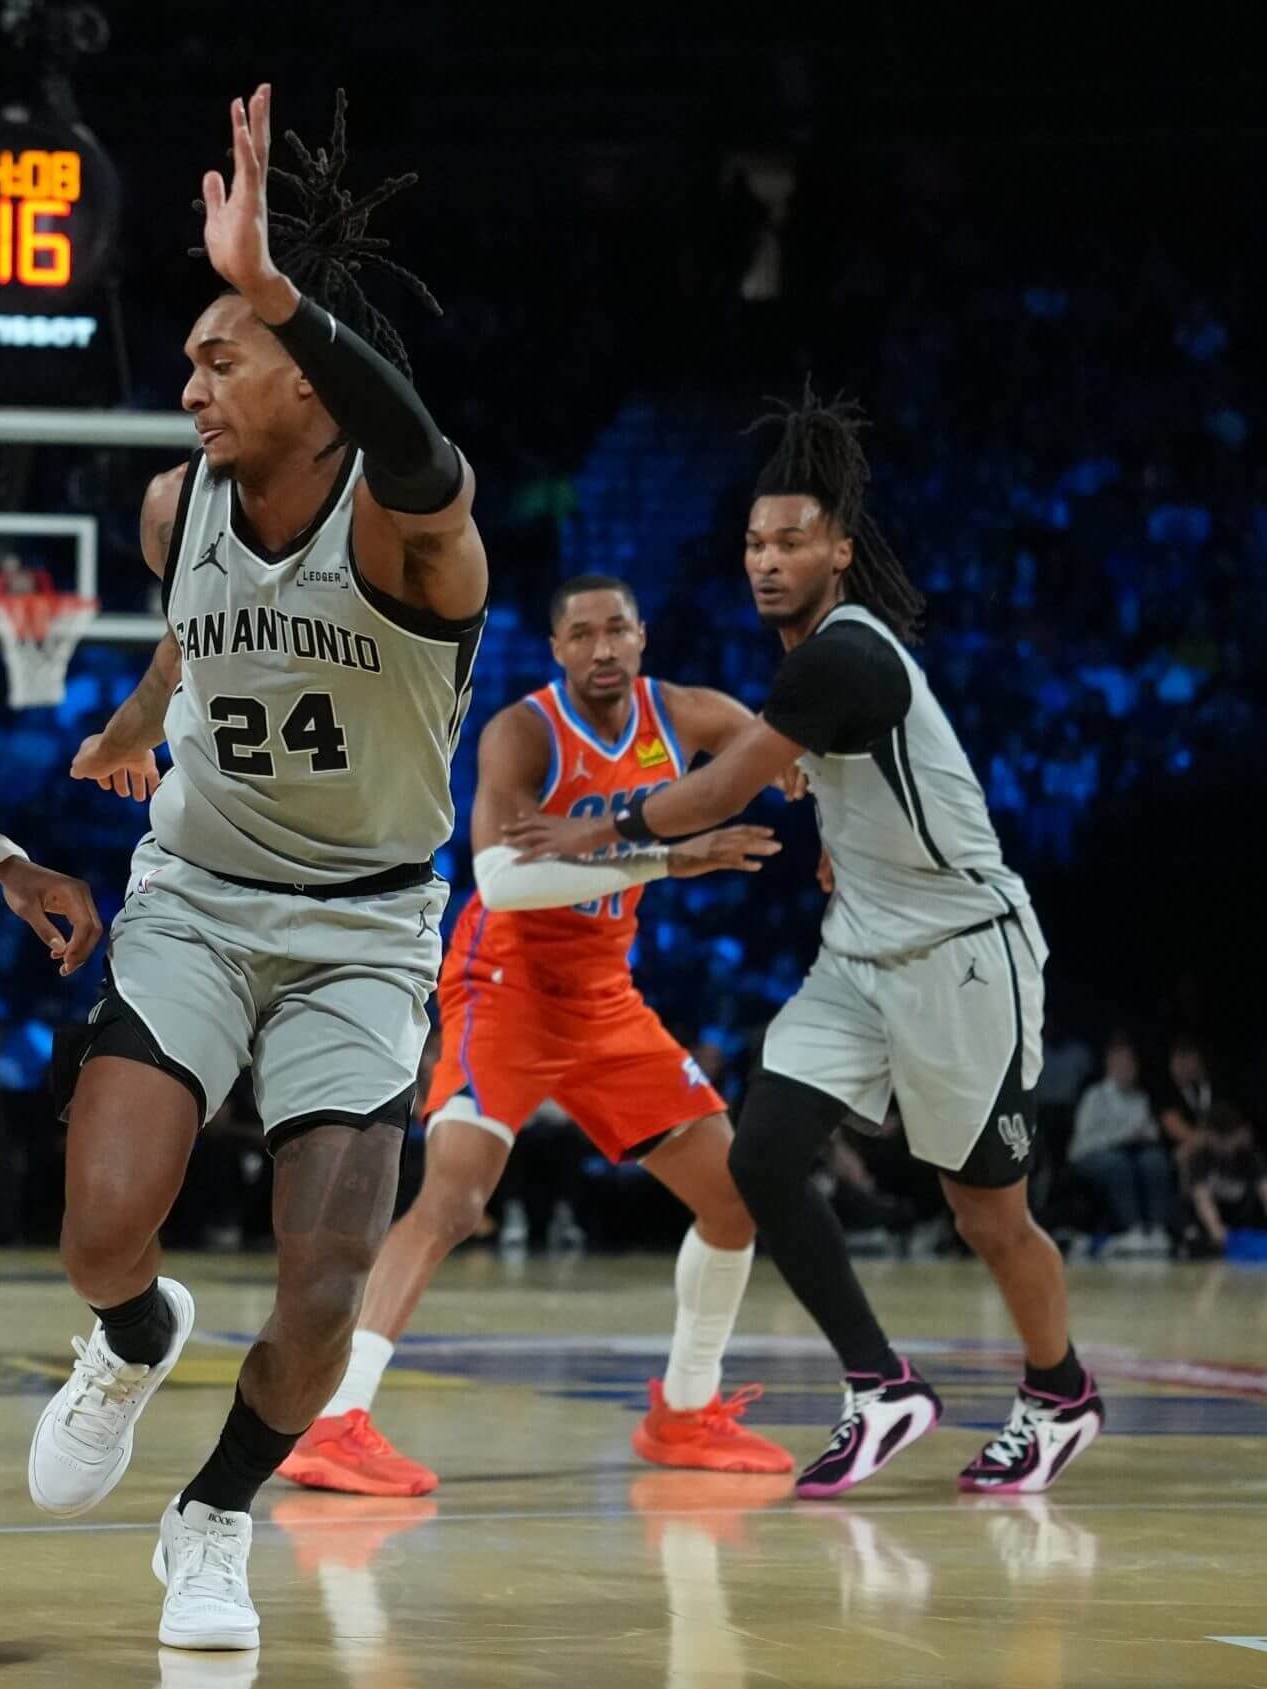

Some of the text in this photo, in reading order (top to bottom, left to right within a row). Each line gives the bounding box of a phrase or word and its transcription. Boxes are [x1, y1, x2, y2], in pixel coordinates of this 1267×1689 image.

[302, 570, 341, 583] LEDGER
[230, 606, 382, 674] ANTONIO
[207, 691, 351, 779] 24
